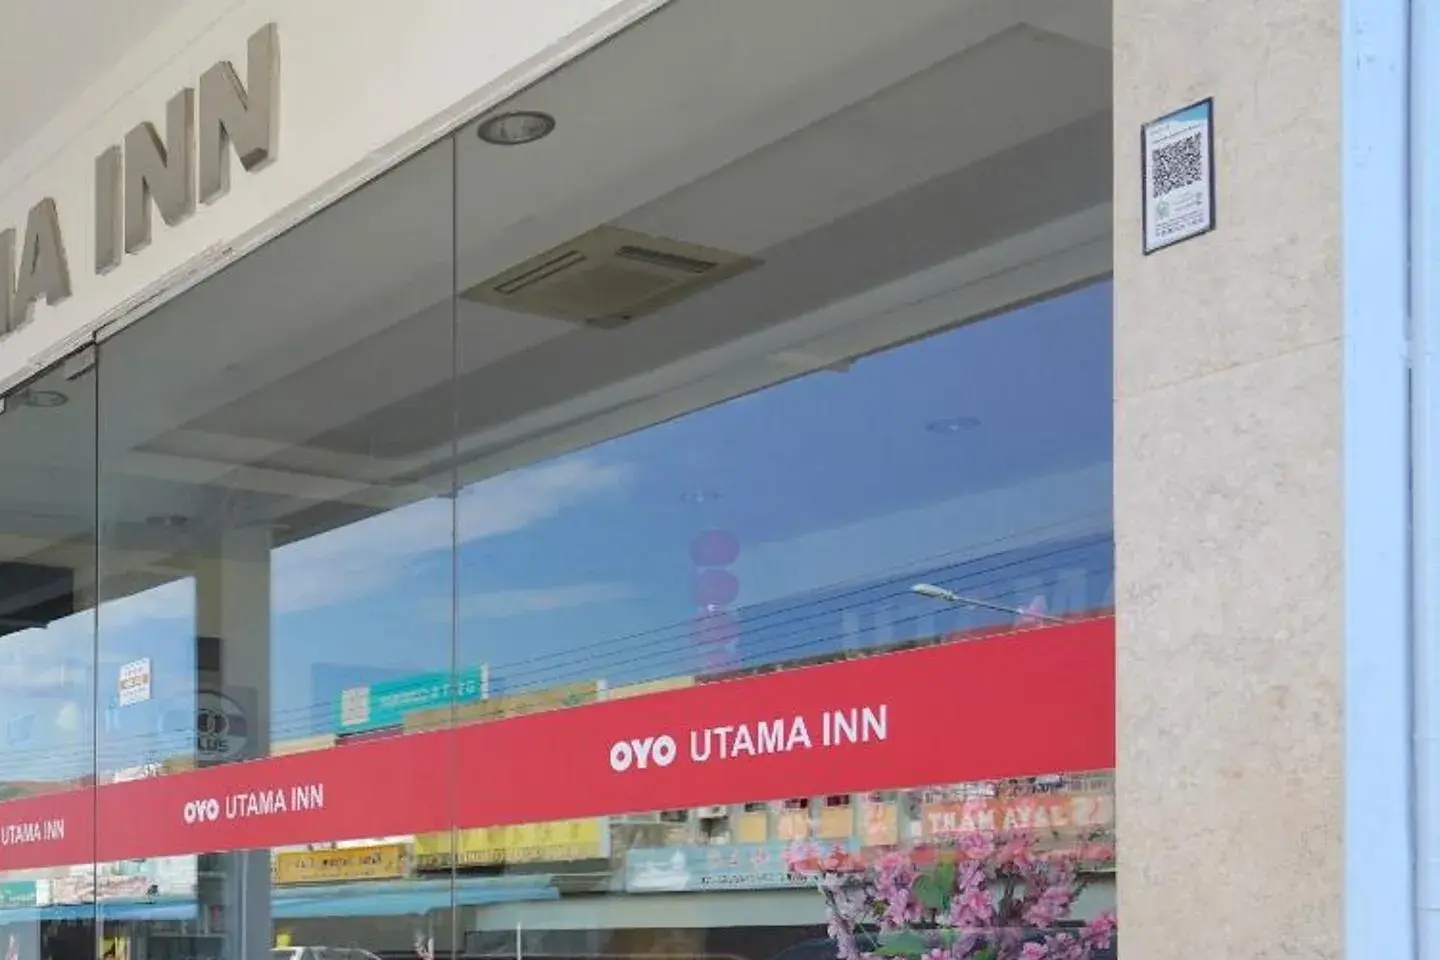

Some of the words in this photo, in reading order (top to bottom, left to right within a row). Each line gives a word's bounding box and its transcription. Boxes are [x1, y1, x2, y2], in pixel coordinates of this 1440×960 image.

[94, 21, 281, 277] INN
[609, 735, 677, 772] OYO
[690, 715, 812, 762] UTAMA
[822, 704, 887, 746] INN
[183, 798, 220, 824] OYO
[225, 788, 287, 819] UTAMA
[291, 783, 324, 811] INN
[1, 822, 41, 845] UTAMA
[43, 818, 65, 839] INN
